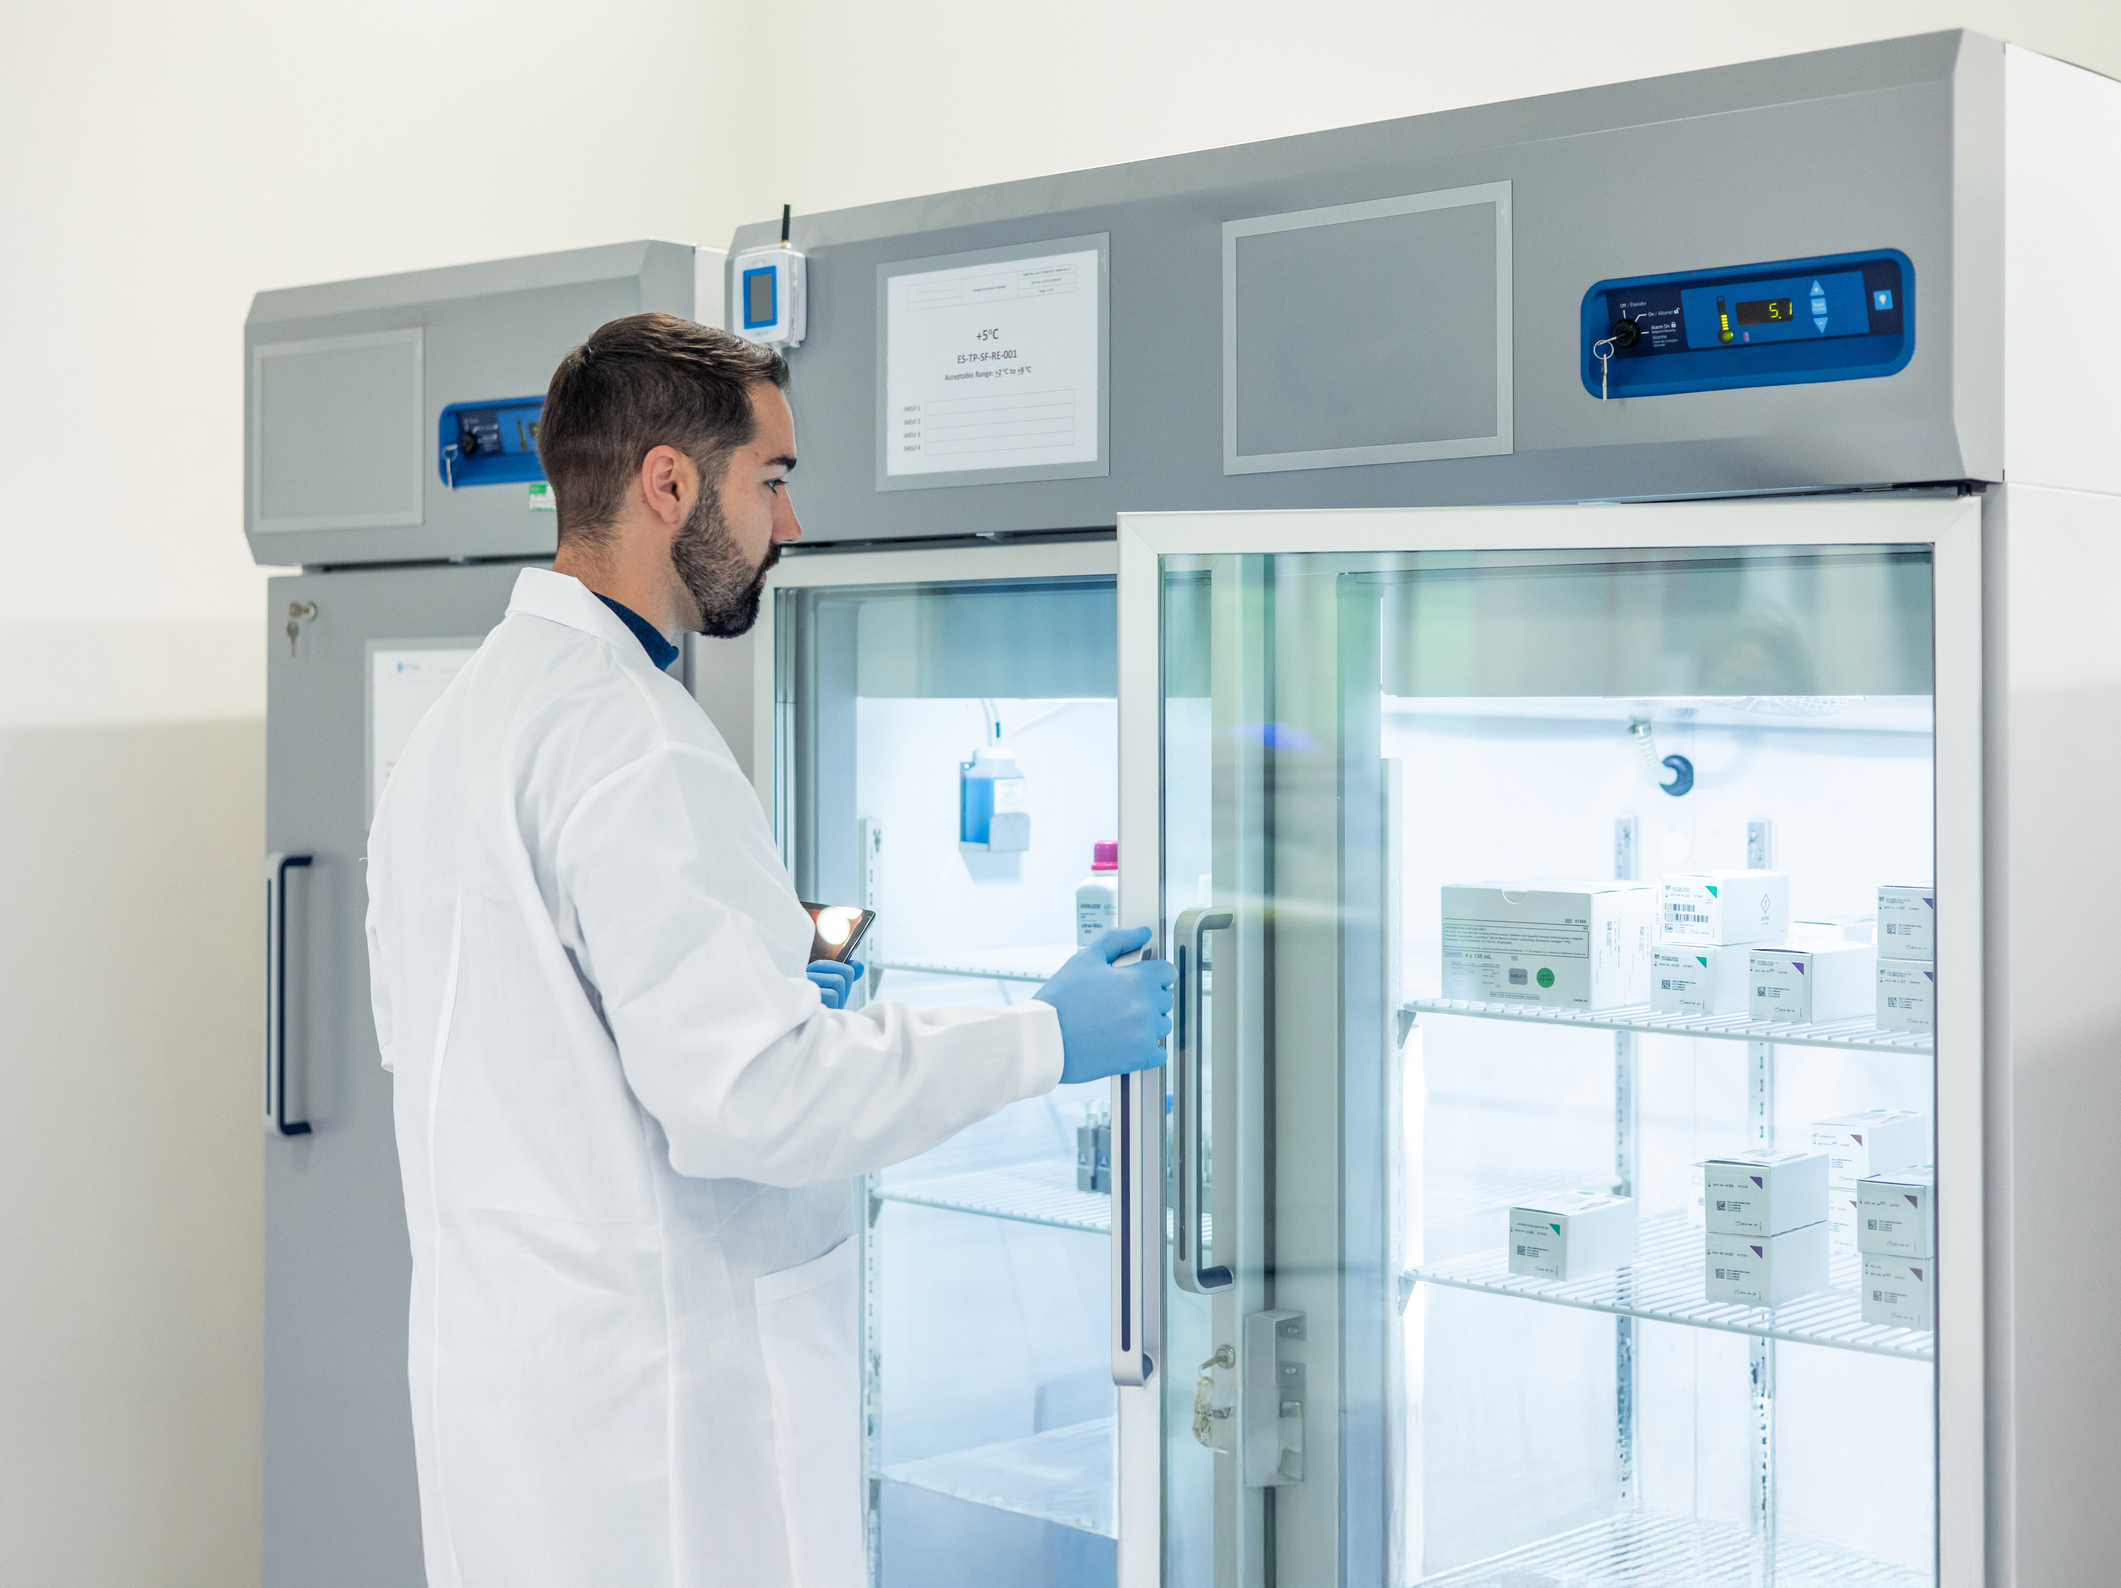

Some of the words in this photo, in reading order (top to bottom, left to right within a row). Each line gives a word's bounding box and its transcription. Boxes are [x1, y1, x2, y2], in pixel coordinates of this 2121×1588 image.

[1769, 302, 1792, 319] 5.1
[976, 328, 999, 341] +5°C
[957, 349, 1017, 364] ES-TP-SF-RE-001
[944, 372, 974, 381] Acceptable
